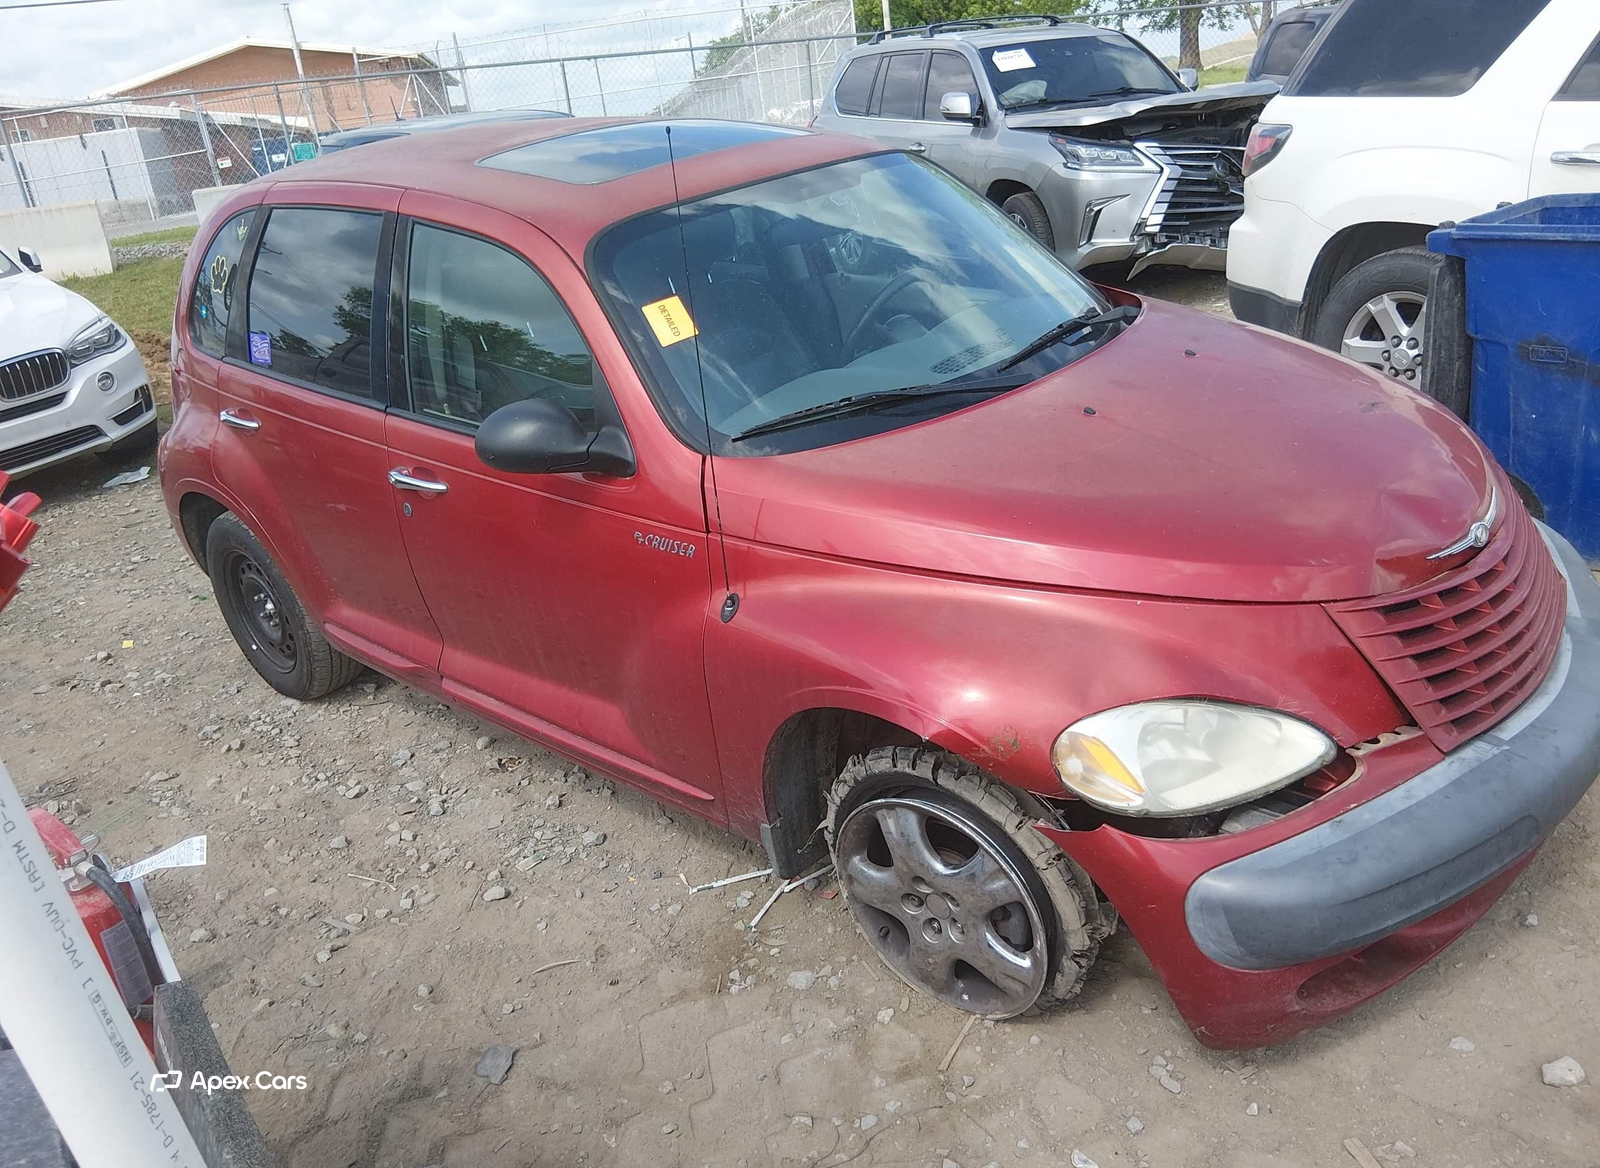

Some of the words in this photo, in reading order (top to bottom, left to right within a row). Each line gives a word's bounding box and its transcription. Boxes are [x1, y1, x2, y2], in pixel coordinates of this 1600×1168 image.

[658, 304, 681, 337] DETAILED
[633, 531, 644, 545] PT
[645, 534, 696, 558] CRUISER
[130, 1071, 174, 1148] D-1785-21
